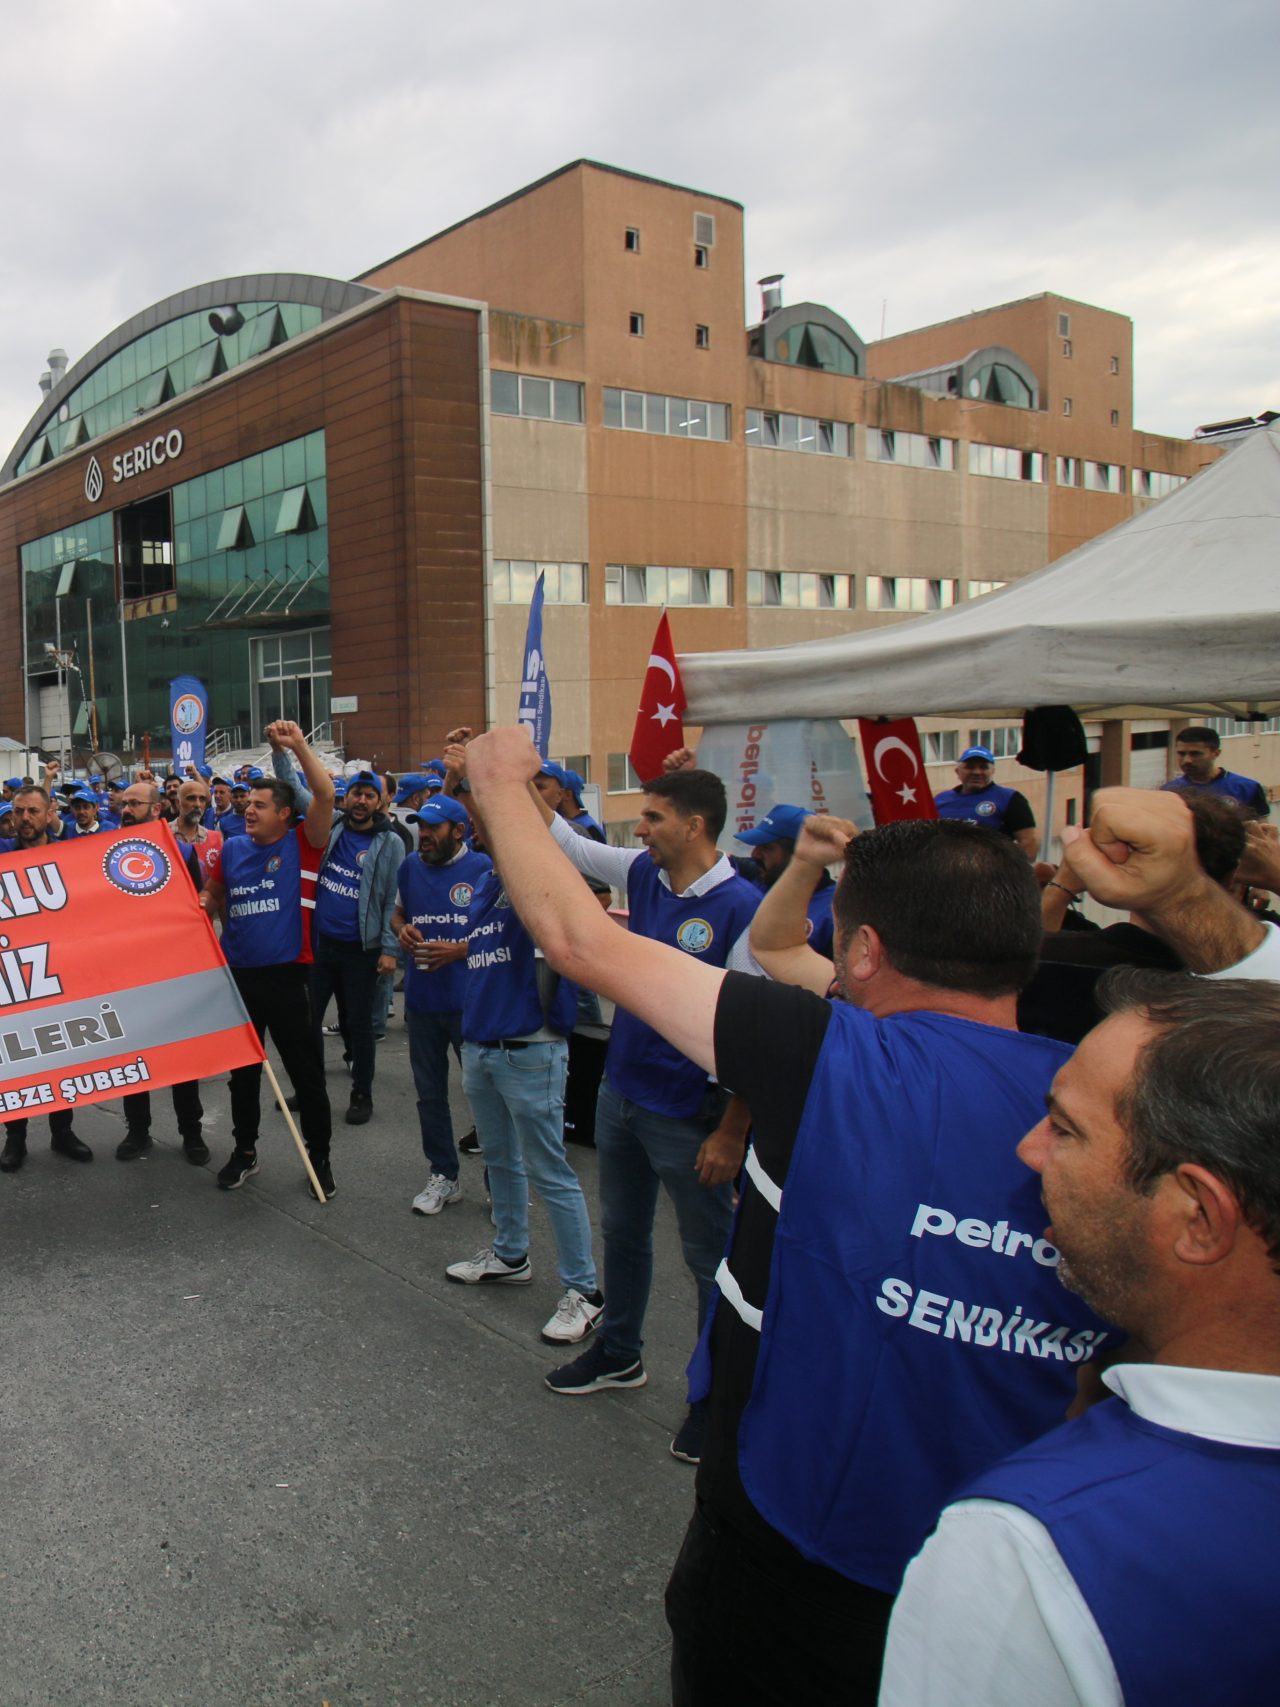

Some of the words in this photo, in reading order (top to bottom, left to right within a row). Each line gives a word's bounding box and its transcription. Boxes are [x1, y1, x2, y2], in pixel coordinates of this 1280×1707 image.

[320, 875, 360, 899] SENDİKAS
[60, 1056, 151, 1103] ŞUBESİ
[910, 1203, 1063, 1267] petro
[875, 1277, 1109, 1363] SENDİKASI
